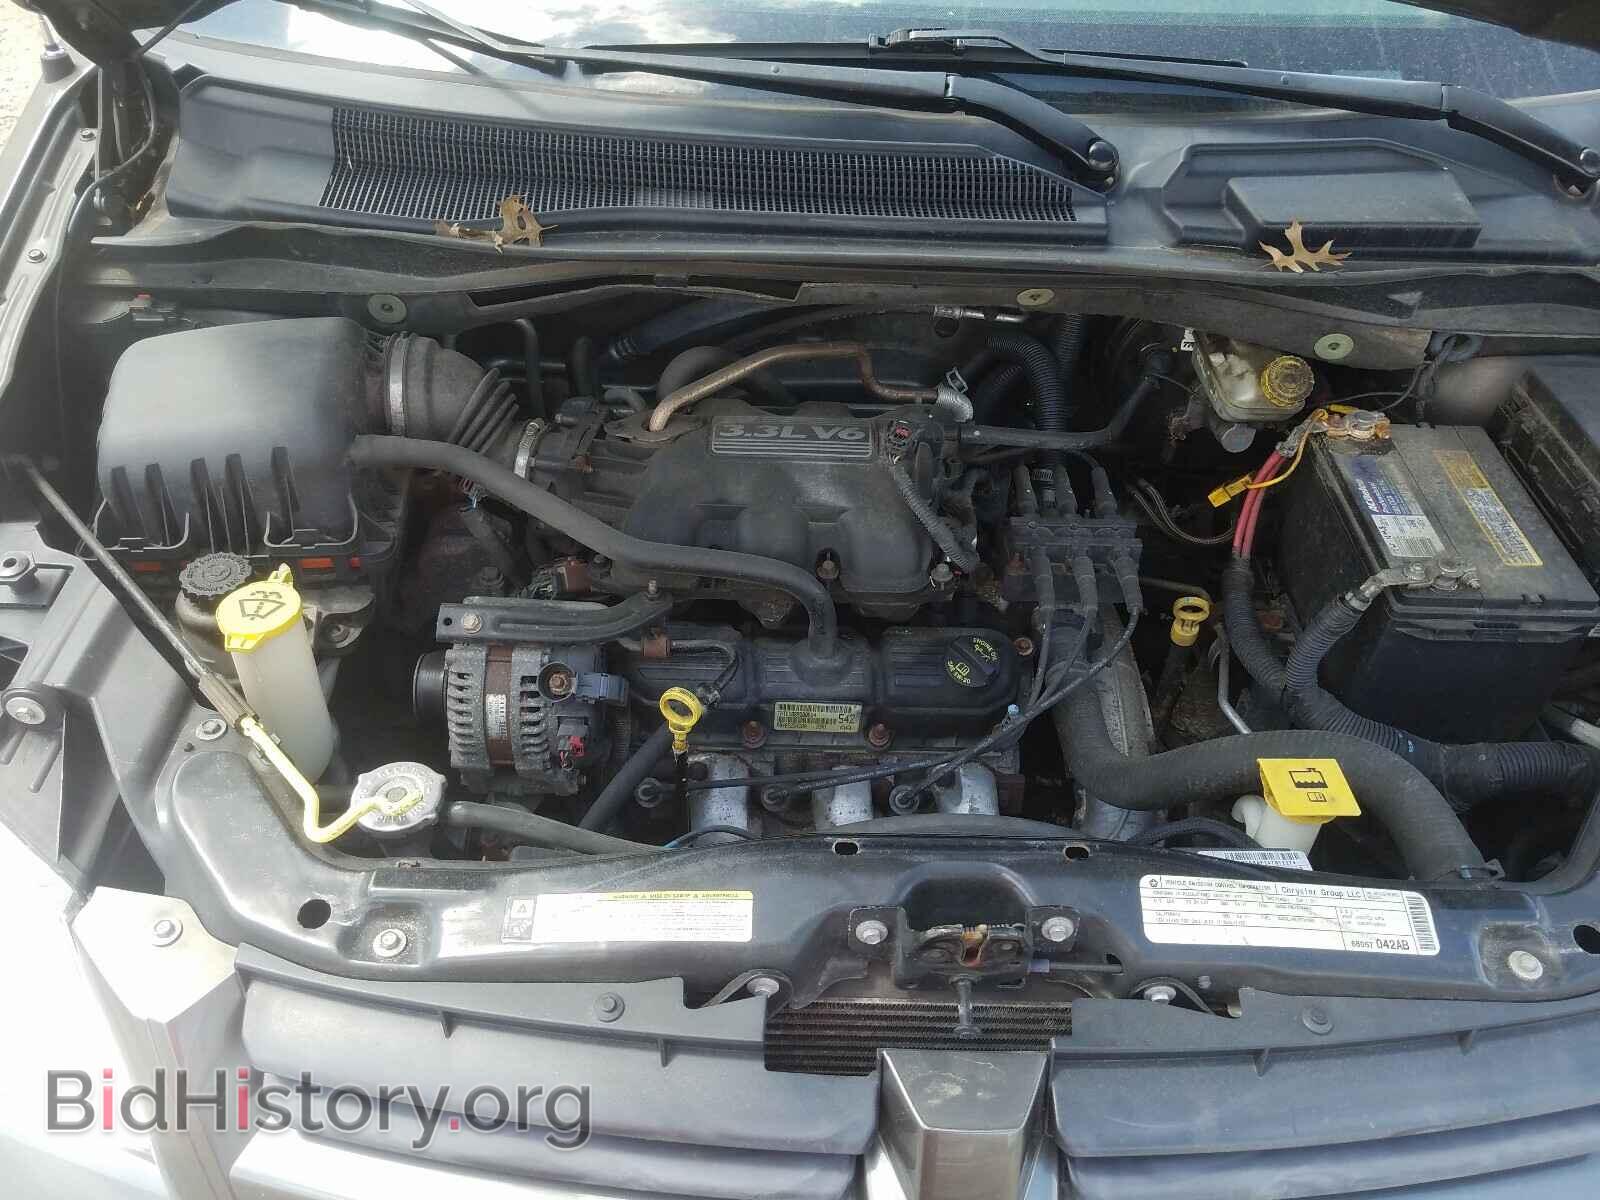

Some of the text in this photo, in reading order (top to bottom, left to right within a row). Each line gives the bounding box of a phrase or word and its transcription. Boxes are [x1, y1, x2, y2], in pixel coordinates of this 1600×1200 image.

[718, 424, 866, 440] 3.3L V6
[1375, 938, 1410, 950] 042AB
